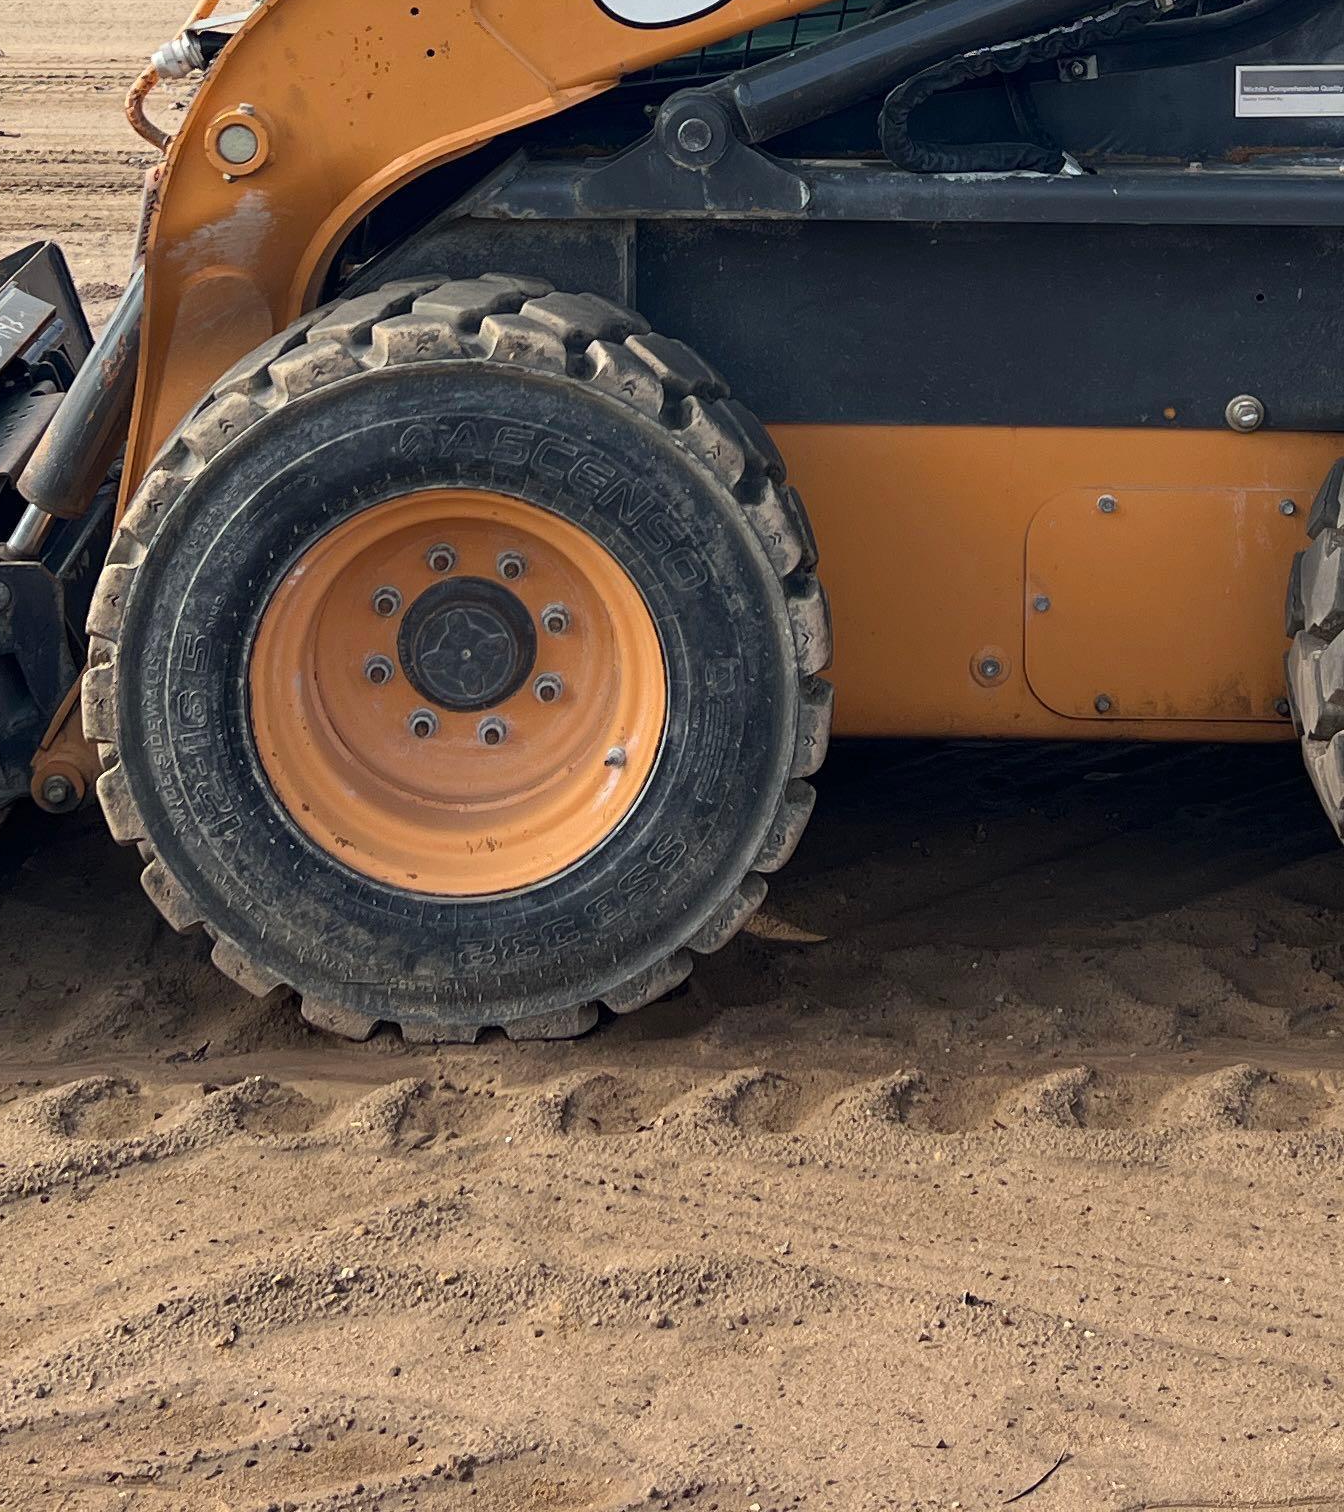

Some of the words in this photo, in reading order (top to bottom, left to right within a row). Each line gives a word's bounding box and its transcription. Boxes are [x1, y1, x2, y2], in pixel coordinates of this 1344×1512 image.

[1268, 84, 1320, 94] Comprehensive
[1320, 84, 1343, 93] Quality
[441, 419, 708, 590] ASCENSO
